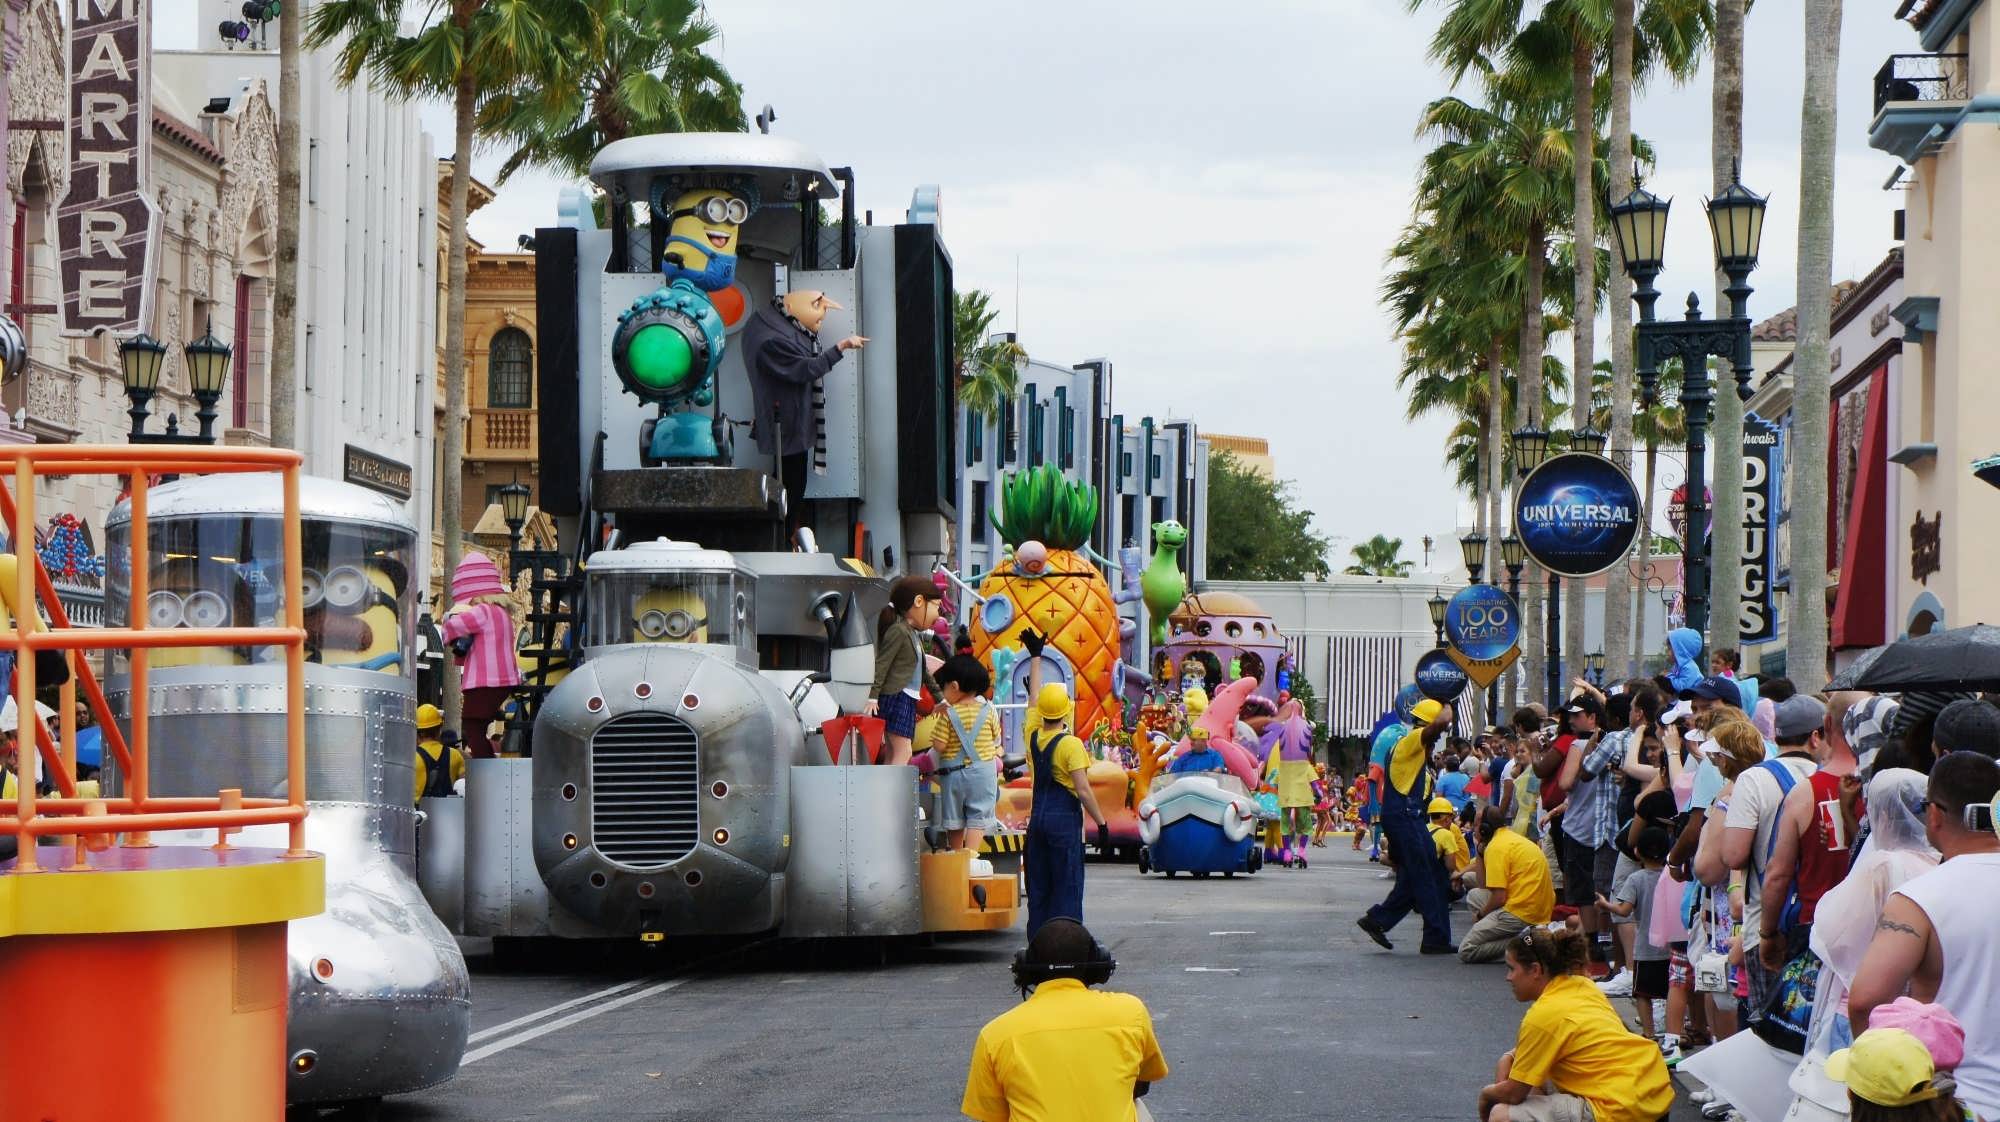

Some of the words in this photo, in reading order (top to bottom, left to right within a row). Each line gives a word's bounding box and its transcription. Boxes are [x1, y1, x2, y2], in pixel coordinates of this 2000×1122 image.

[1524, 504, 1633, 522] UNIVERSAL
[1740, 456, 1766, 634] DRUGS
[1460, 606, 1508, 626] 100
[1458, 626, 1508, 640] YEARS
[1418, 670, 1466, 679] UNIVERSAL
